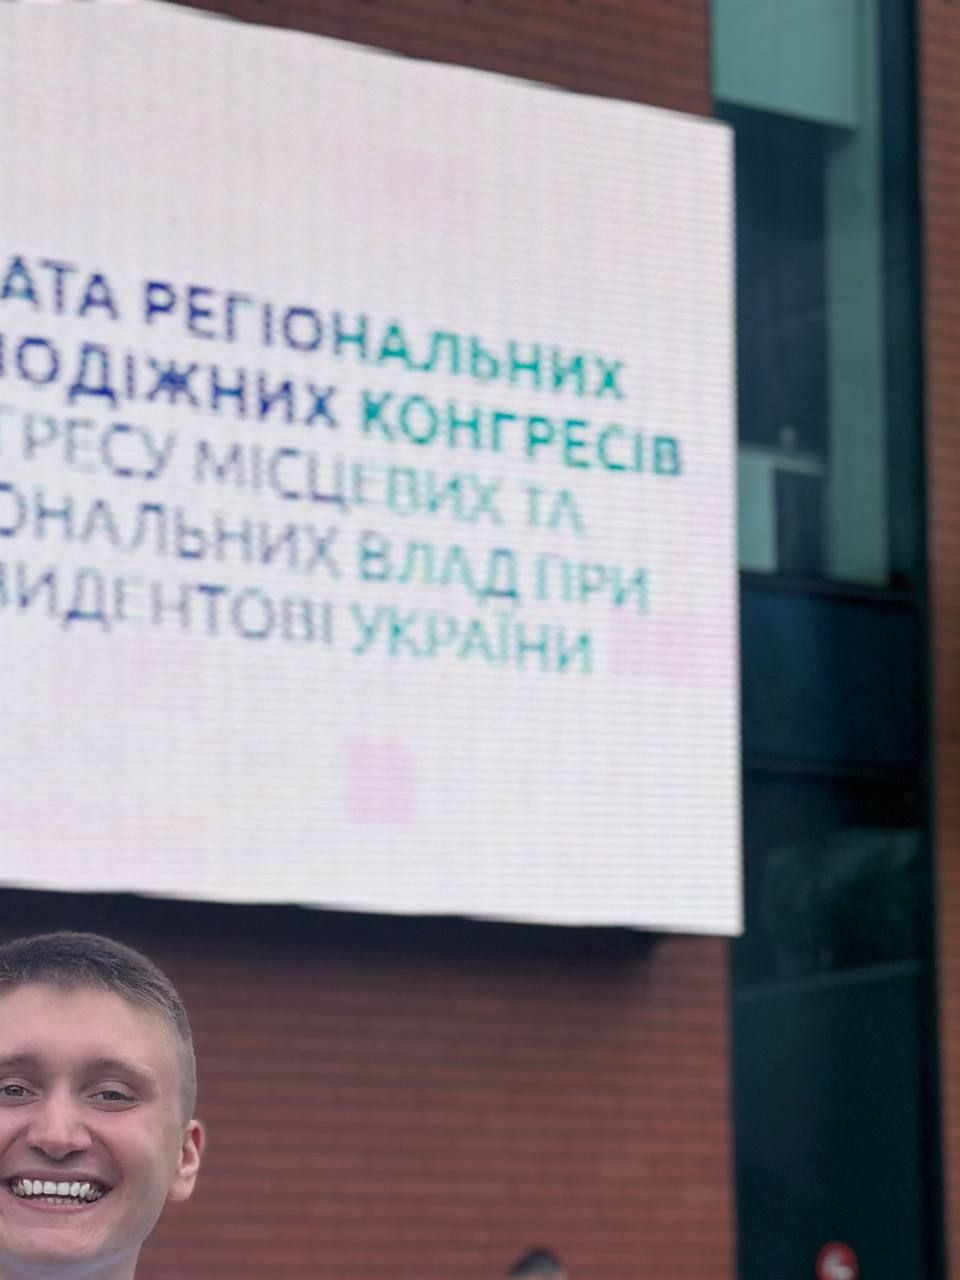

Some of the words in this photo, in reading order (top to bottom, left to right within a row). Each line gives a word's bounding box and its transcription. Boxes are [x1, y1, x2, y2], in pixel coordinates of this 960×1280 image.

[144, 279, 627, 400] РЕГІОНАЛЬНИХ
[360, 388, 682, 477] КОНГРЕСІВ
[194, 438, 503, 527] МІСЦЕВИХ
[524, 482, 586, 537] ТА
[356, 529, 520, 608] ВЛАД
[535, 553, 651, 616] ПРИ
[350, 599, 594, 676] УКРАЇНИ
